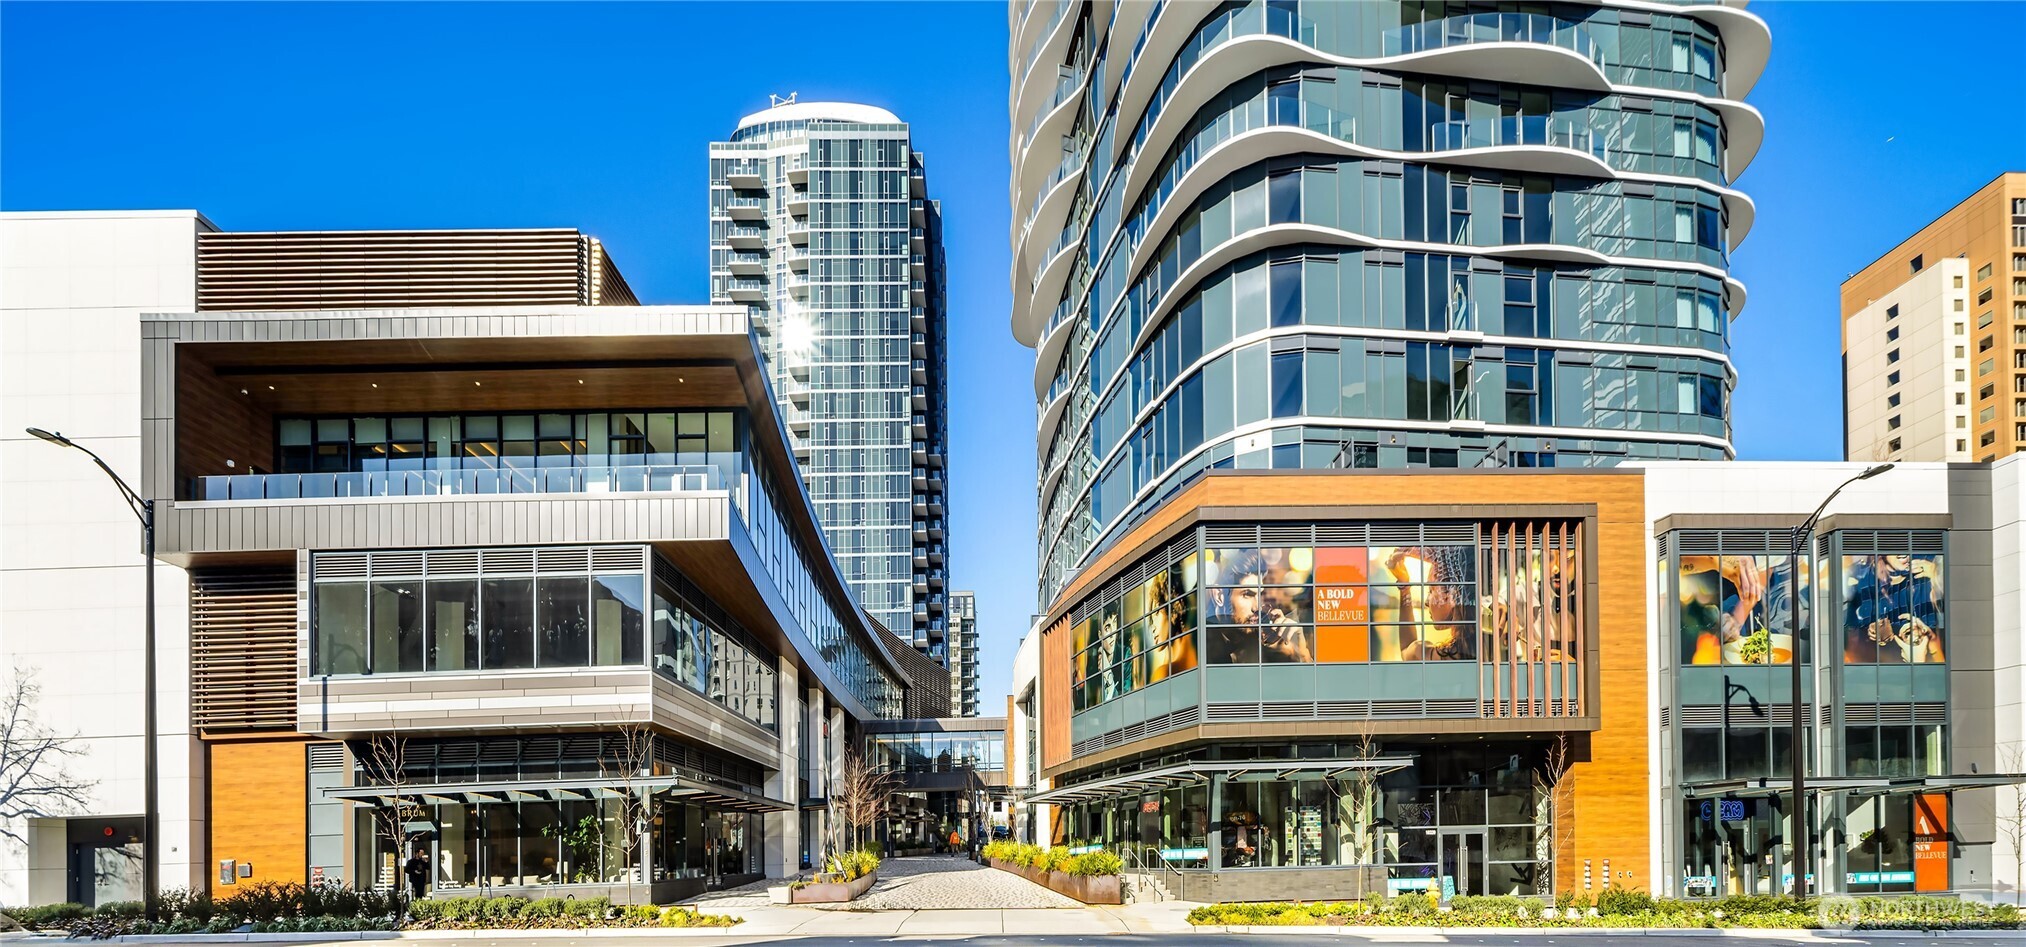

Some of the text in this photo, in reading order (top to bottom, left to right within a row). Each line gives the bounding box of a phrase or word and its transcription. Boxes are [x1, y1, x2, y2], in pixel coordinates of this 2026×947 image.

[1317, 589, 1354, 599] A BOLD
[1317, 600, 1341, 610] NEW
[1317, 611, 1365, 621] BELLEVUE
[1915, 836, 1934, 844] BOLD
[1915, 851, 1947, 859] BELLEVUE
